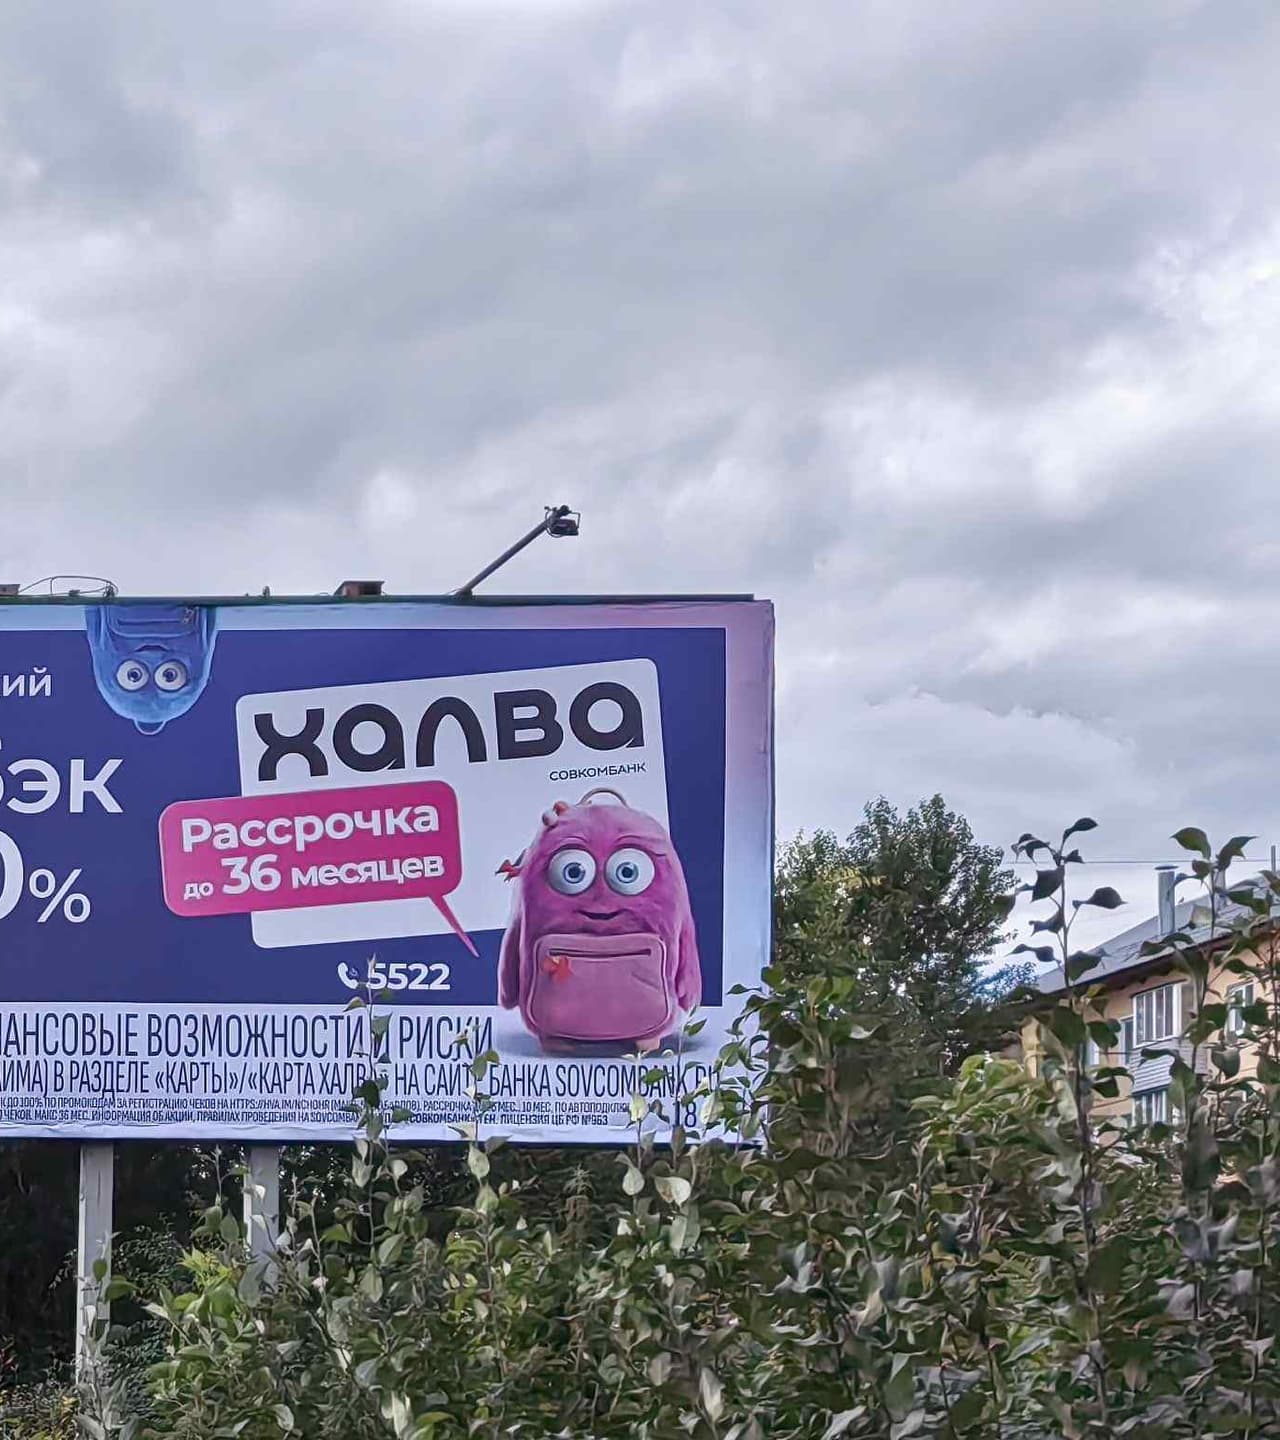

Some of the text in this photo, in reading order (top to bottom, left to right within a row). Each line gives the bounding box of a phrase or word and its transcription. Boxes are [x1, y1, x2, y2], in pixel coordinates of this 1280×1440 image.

[549, 762, 647, 782] СОВКОМБАНК
[181, 804, 440, 852] Рассрочка
[183, 853, 445, 901] до 36 месяцев
[366, 962, 451, 990] 5522
[147, 1013, 363, 1058] ВОЗМОЖНОСТИ
[399, 1015, 494, 1060] РИСКИ
[54, 1060, 65, 1092] В
[70, 1060, 149, 1098] РАЗДЕЛЕ
[395, 1063, 420, 1096] НА
[424, 1058, 484, 1096] САЙТ
[489, 1064, 551, 1097] БАНКА
